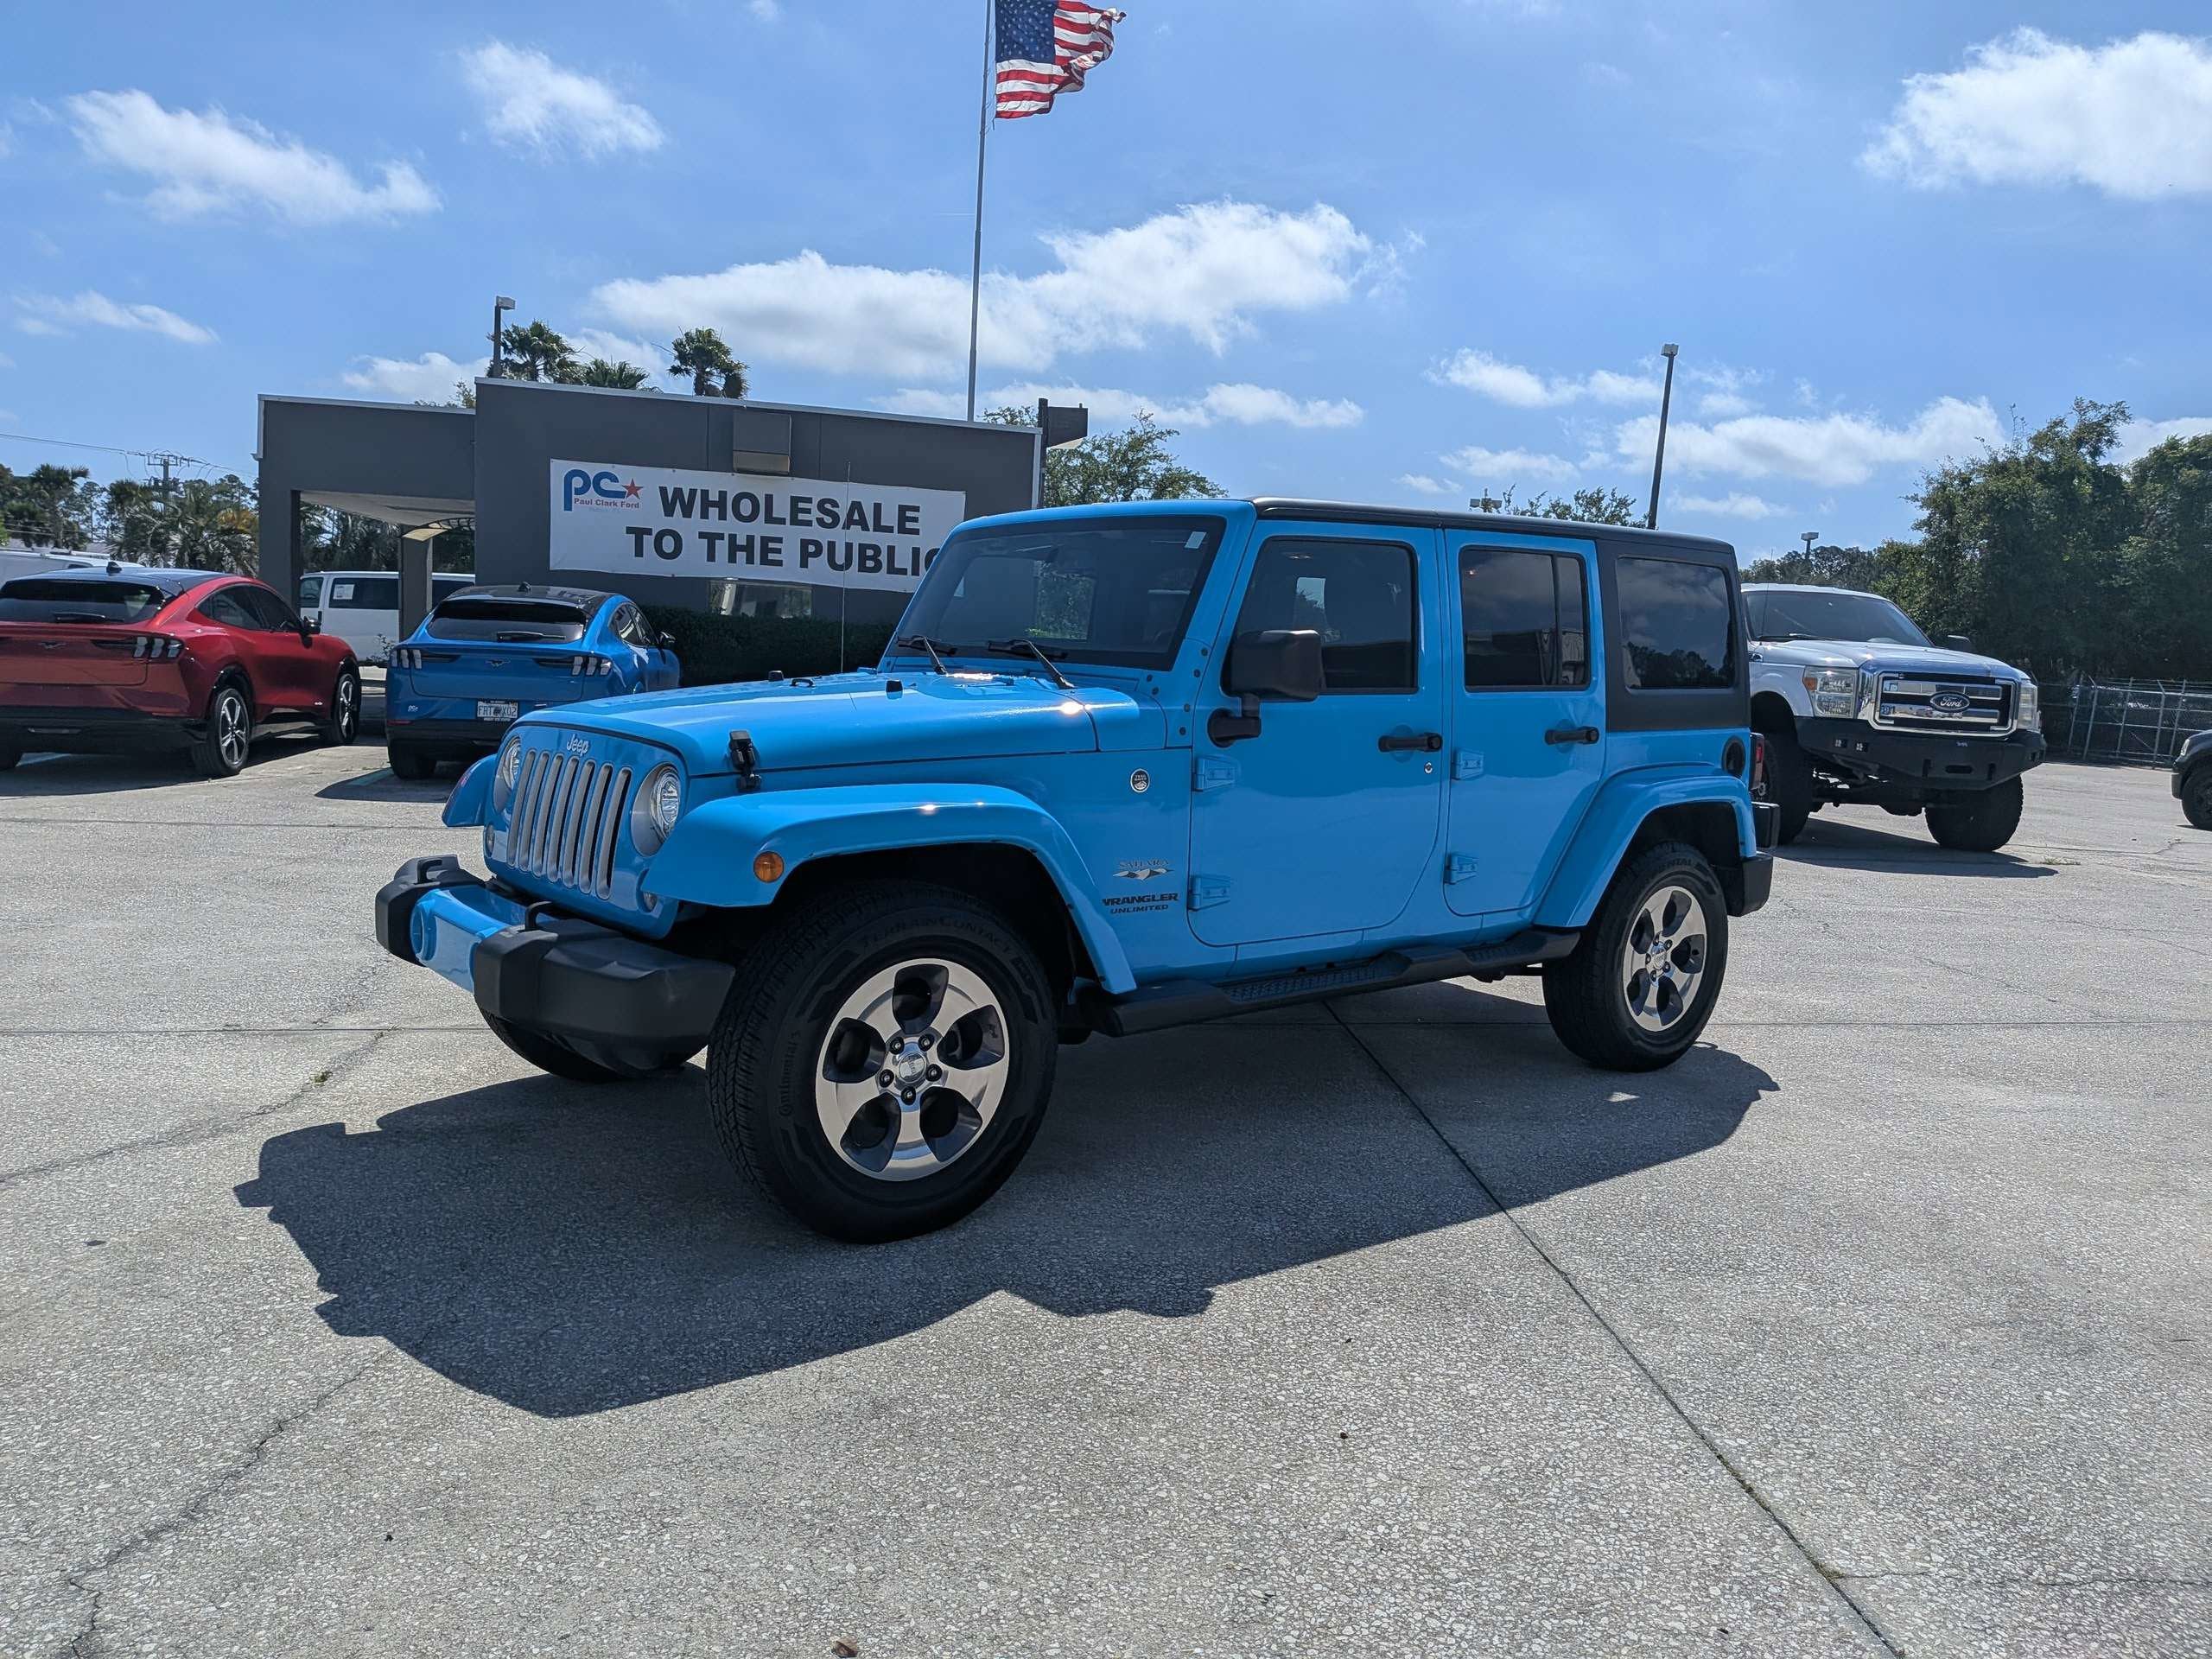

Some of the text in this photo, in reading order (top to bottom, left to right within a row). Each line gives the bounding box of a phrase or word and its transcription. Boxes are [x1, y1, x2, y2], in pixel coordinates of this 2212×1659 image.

[595, 499, 618, 508] Clark
[658, 486, 921, 536] WHOLESALE
[626, 526, 683, 560] TO
[698, 531, 784, 567] THE
[1940, 696, 1963, 707] Ford
[566, 734, 590, 756] Jeep
[1102, 893, 1179, 906] WRANGLER
[1110, 904, 1169, 914] UNLIMITED
